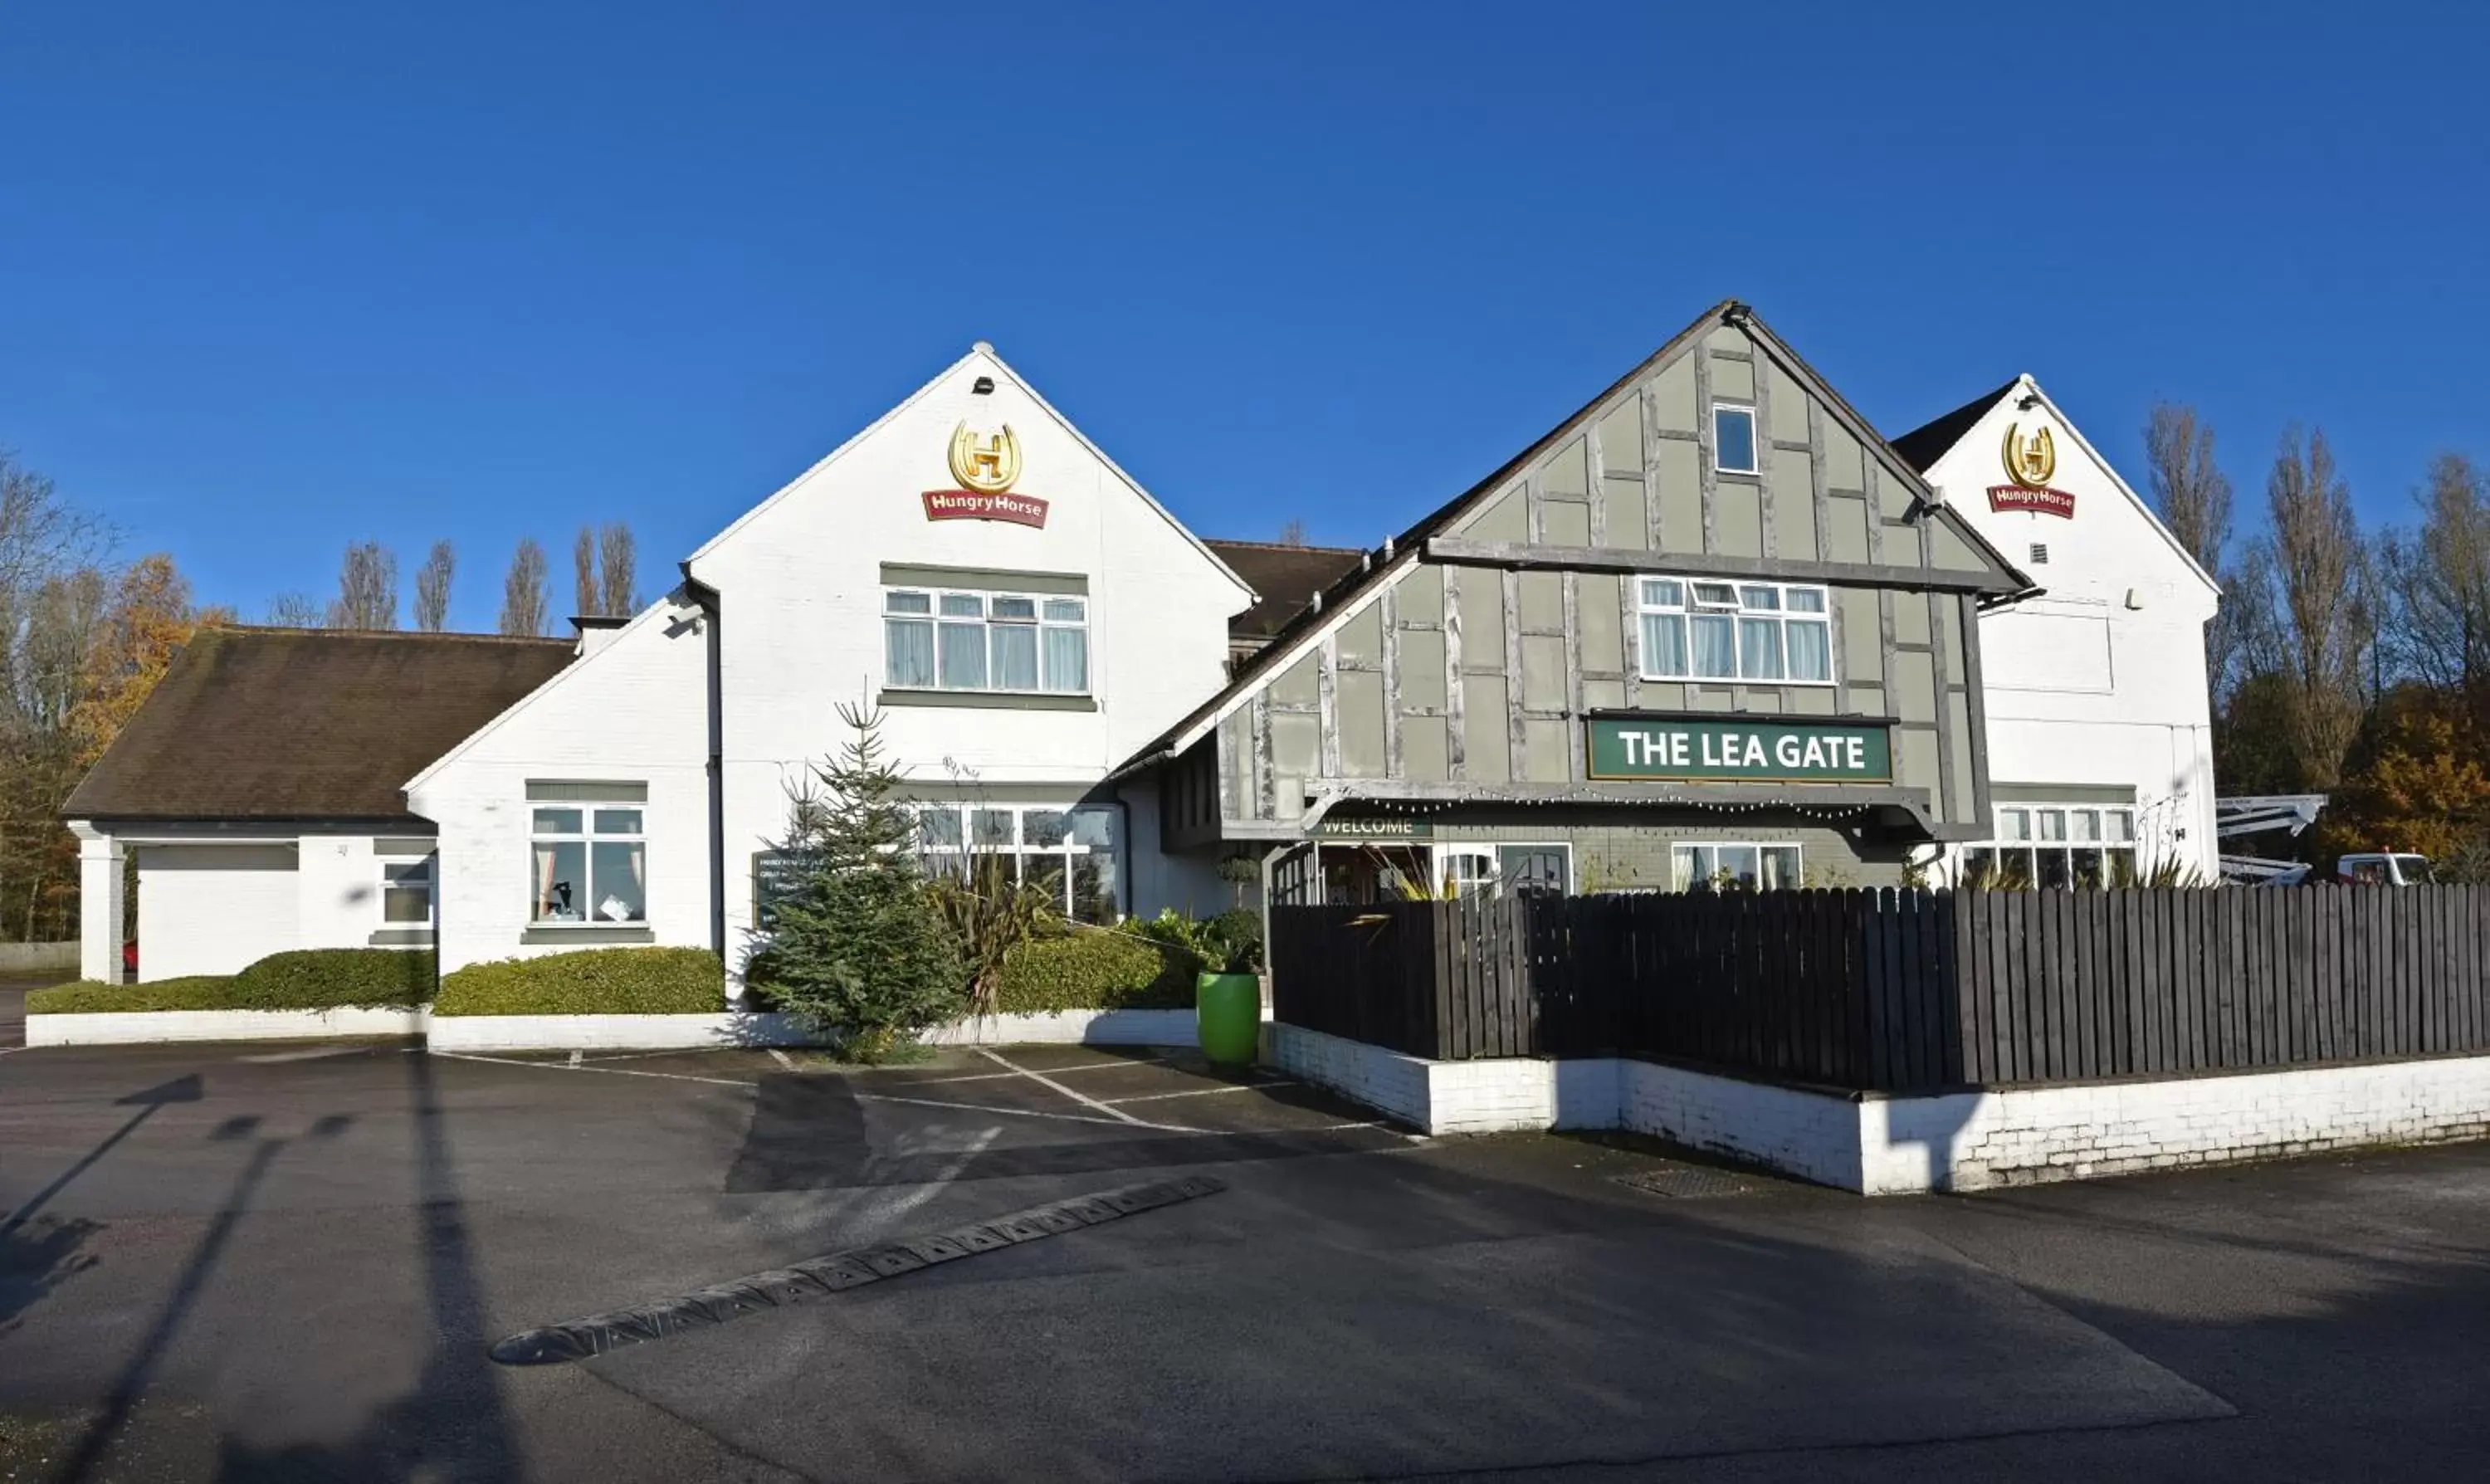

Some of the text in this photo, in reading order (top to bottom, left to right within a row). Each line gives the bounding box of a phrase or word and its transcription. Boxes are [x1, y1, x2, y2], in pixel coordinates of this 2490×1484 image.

[1618, 731, 1865, 769] THE LEA GATE
[1323, 818, 1414, 833] WELCOME
